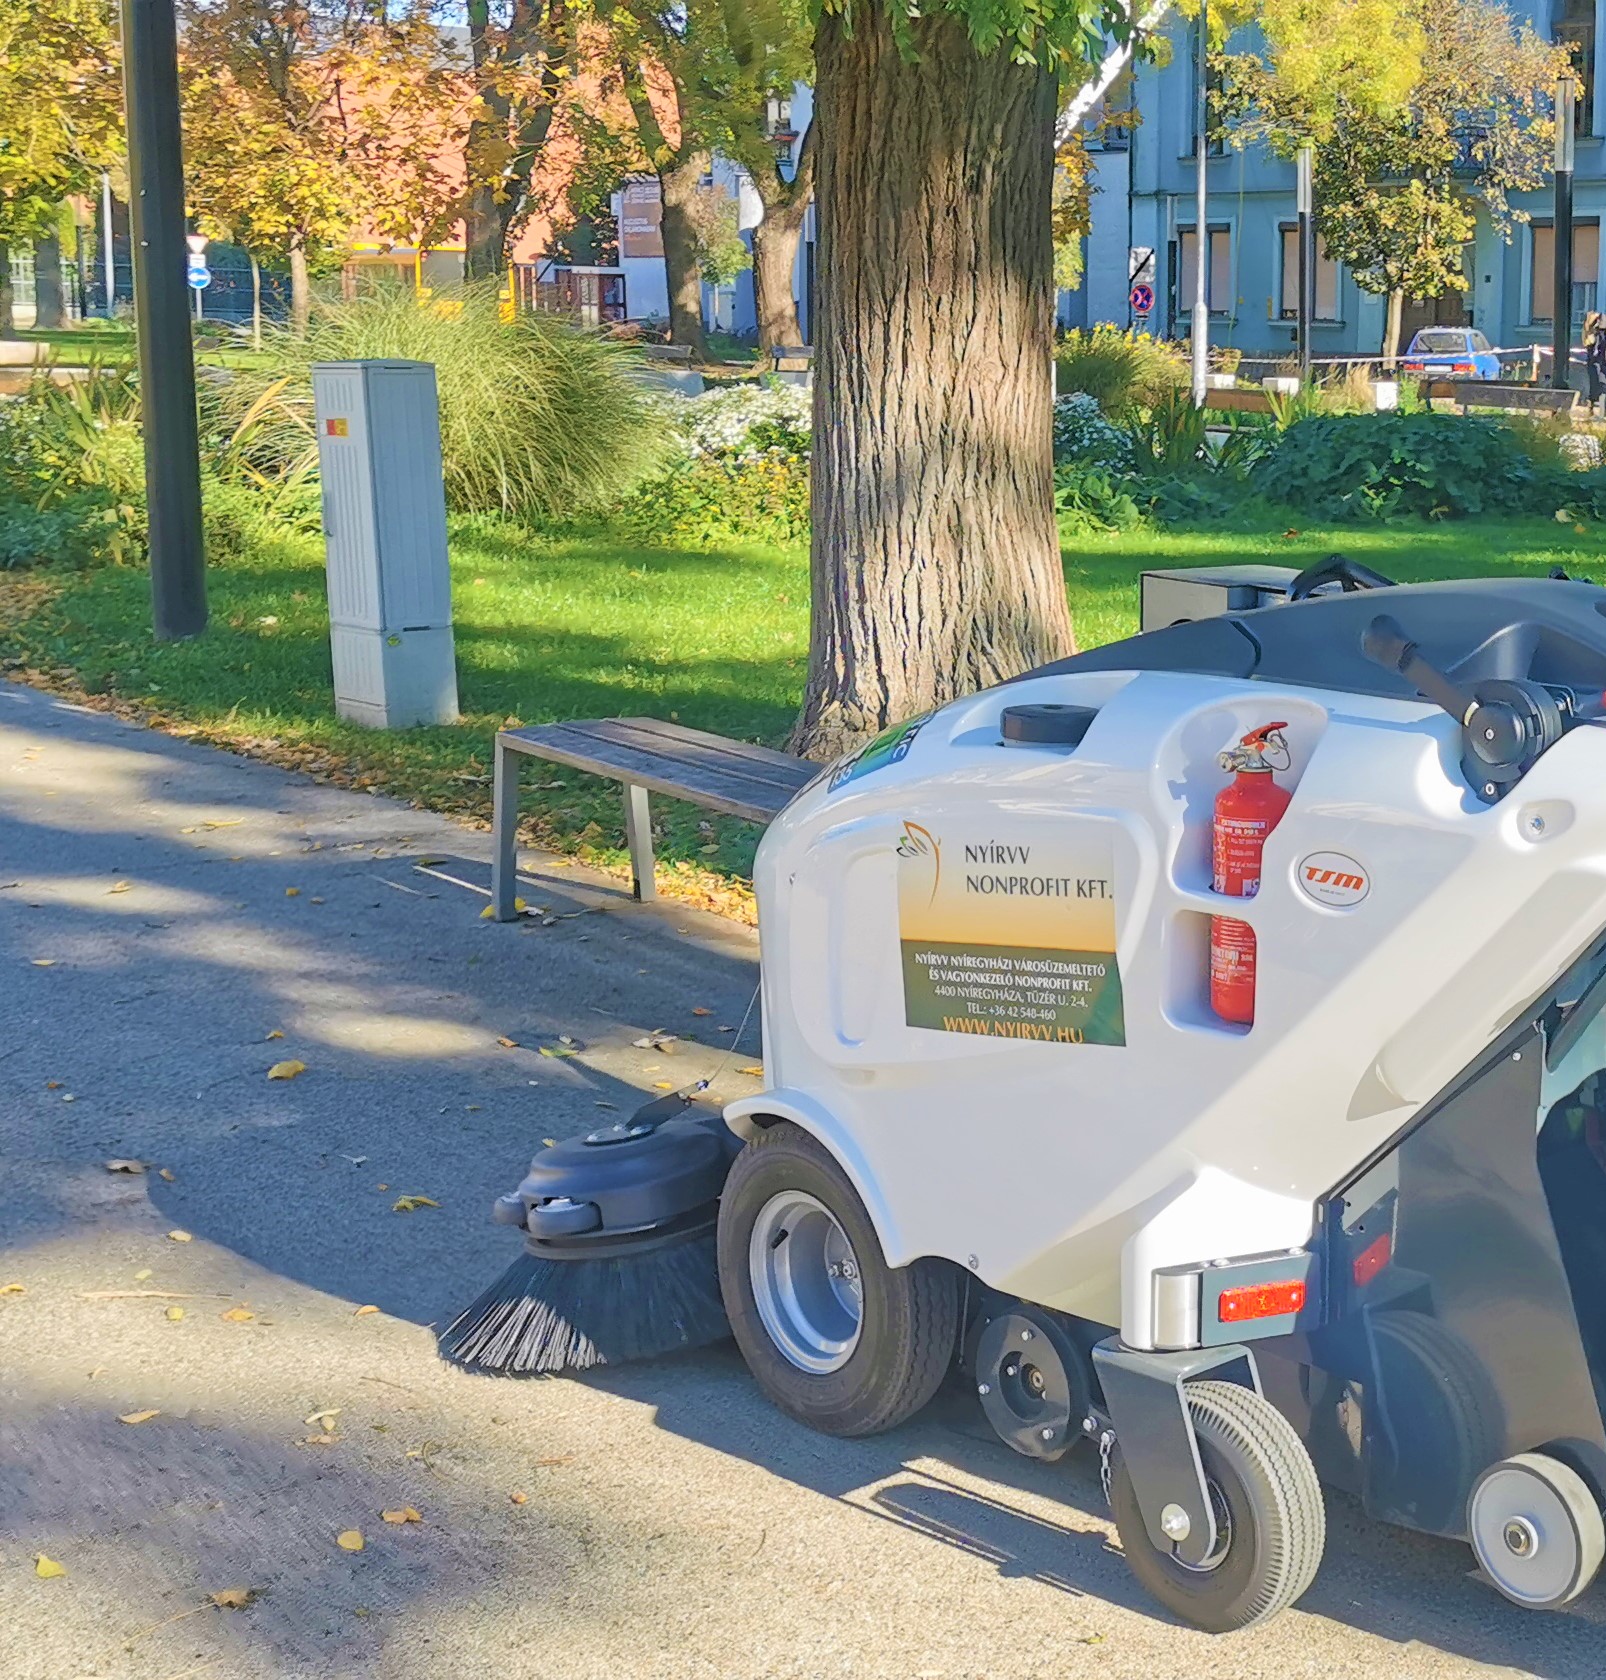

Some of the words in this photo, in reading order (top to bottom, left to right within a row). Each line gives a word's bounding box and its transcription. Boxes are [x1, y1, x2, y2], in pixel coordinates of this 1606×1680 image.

[965, 839, 1030, 865] NYÍRVV
[966, 874, 1070, 898] NONPROFIT
[1077, 879, 1113, 900] KFT.
[914, 950, 949, 966] NYÍRVV
[950, 953, 1012, 970] NYÍREGYHÁZI
[928, 966, 940, 981] ÉS
[1015, 975, 1071, 991] NONPROFIT
[1072, 980, 1093, 992] KFT.
[934, 985, 956, 997] 4400
[1058, 994, 1069, 1006] U.
[989, 1004, 1006, 1016] +36
[1007, 1006, 1020, 1018] 42
[942, 1015, 1085, 1044] WWW.NYIRVV.HU
